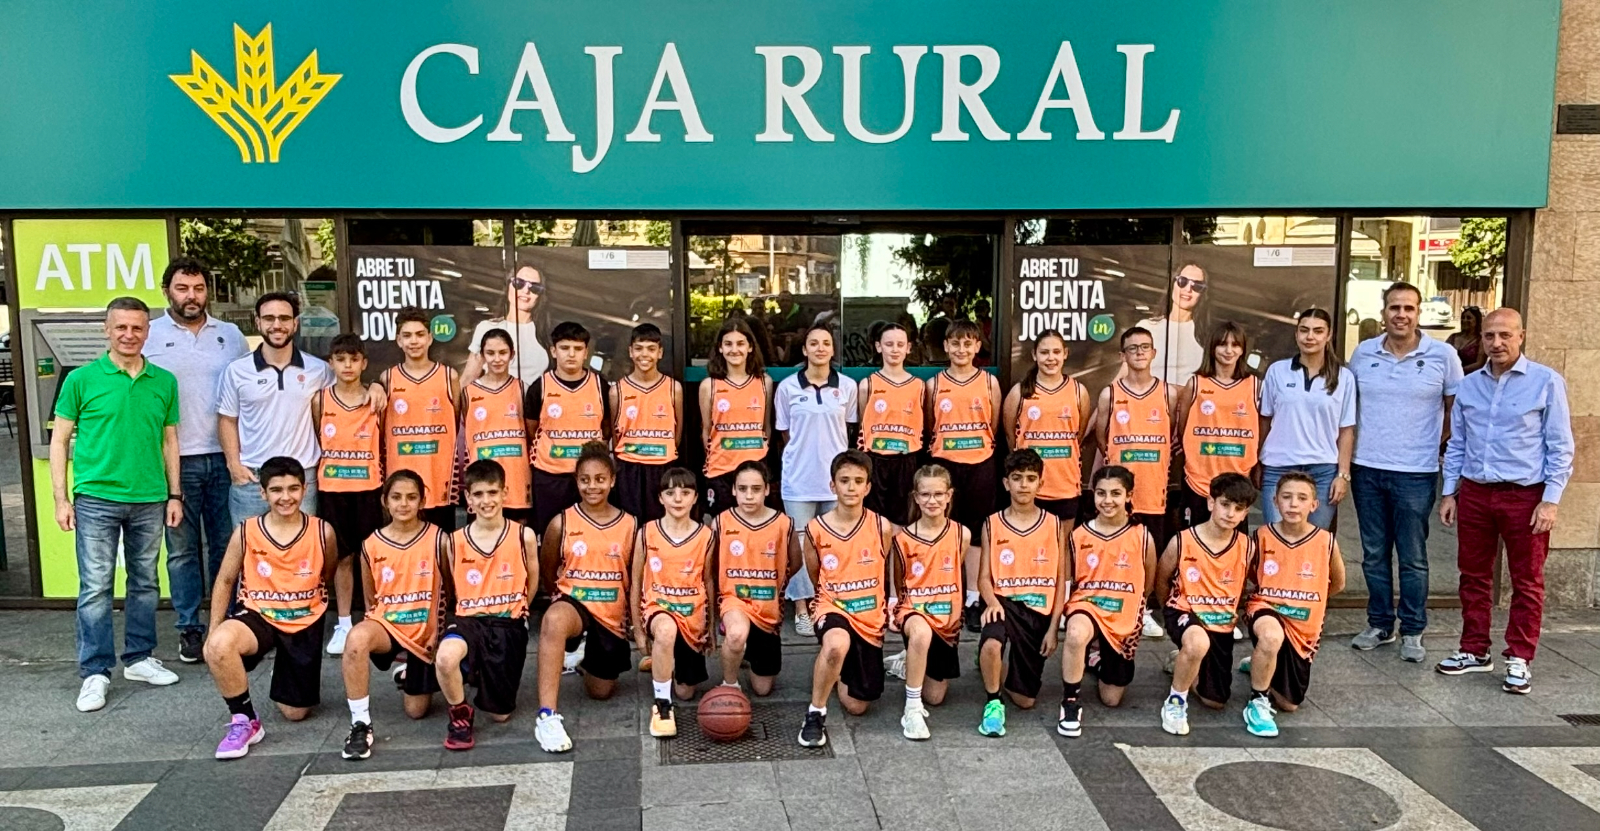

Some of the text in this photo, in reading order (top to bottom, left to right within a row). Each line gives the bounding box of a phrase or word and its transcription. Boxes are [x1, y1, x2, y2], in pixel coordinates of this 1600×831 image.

[400, 40, 1180, 174] CAJA RURAL
[36, 243, 155, 290] ATM
[356, 257, 415, 278] ABRE TU
[1019, 258, 1079, 278] ABRE TU
[357, 279, 445, 310] CUENTA
[1019, 279, 1106, 310] CUENTA
[359, 311, 399, 342] JOV
[434, 320, 453, 336] in
[1018, 311, 1088, 342] JOVEN
[1092, 319, 1112, 336] in
[548, 429, 602, 440] ALAMANCA
[625, 430, 673, 440] ALAMANCA
[714, 422, 763, 432] SALAMANC
[1192, 426, 1253, 439] SALAMANCA
[1113, 435, 1167, 445] SALAMANCA
[565, 569, 622, 581] SALAMANC
[726, 568, 777, 580] SALAMANC
[825, 577, 878, 593] SLAMANC
[379, 590, 432, 605] ALAMANC
[1260, 586, 1320, 603] ALAMANCA
